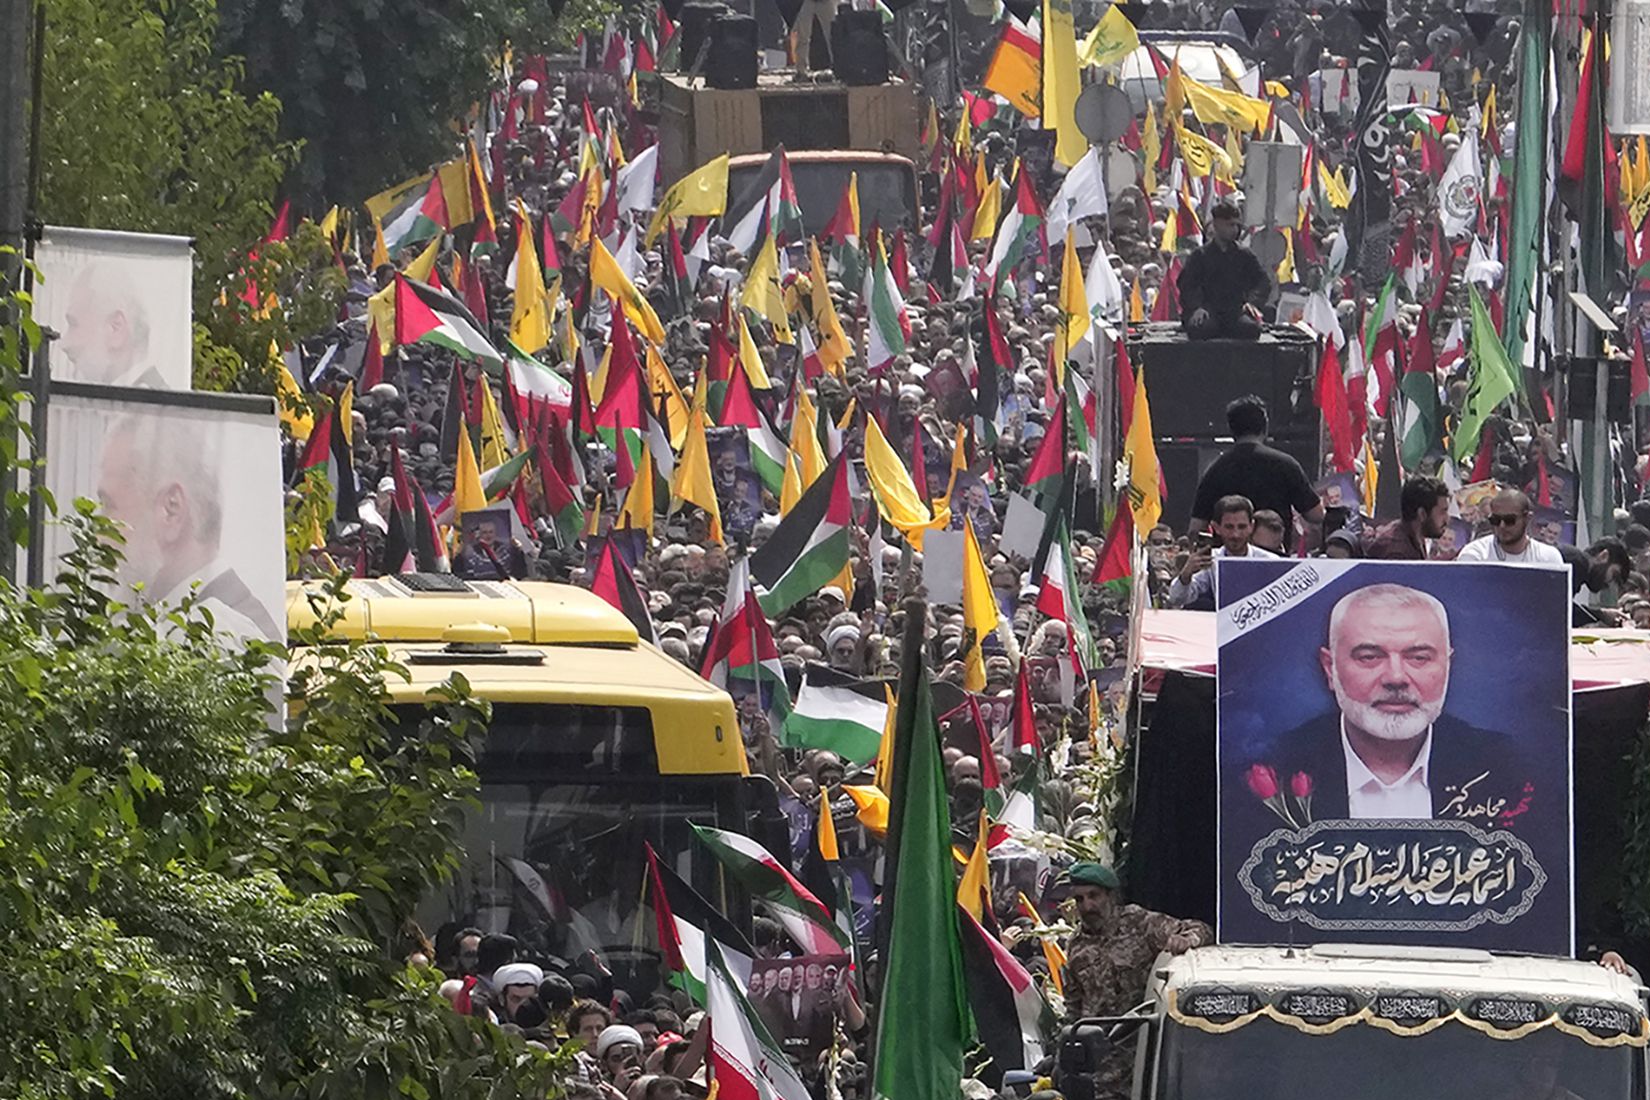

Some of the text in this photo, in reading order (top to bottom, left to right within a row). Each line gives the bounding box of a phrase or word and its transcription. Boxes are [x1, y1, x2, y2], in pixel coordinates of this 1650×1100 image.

[1438, 771, 1535, 827] شهید مجاهد دکتر
